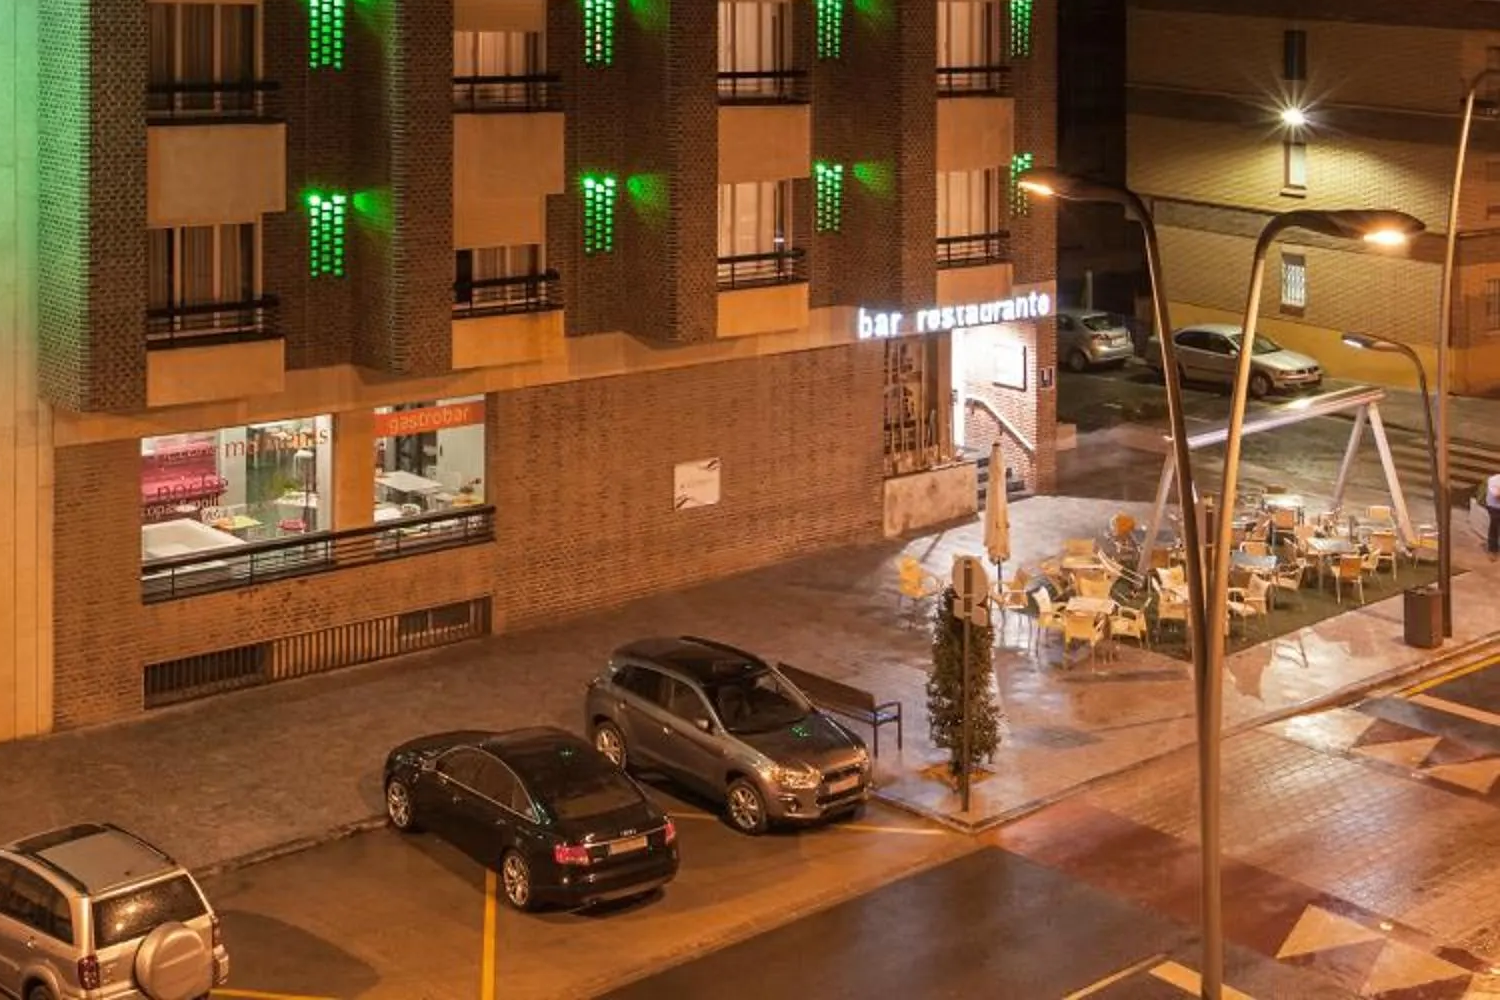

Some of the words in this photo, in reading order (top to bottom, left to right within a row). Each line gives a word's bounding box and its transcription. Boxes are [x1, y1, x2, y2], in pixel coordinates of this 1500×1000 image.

[858, 306, 903, 339] bar
[916, 291, 1050, 332] restaurante
[387, 406, 469, 434] gastrobar
